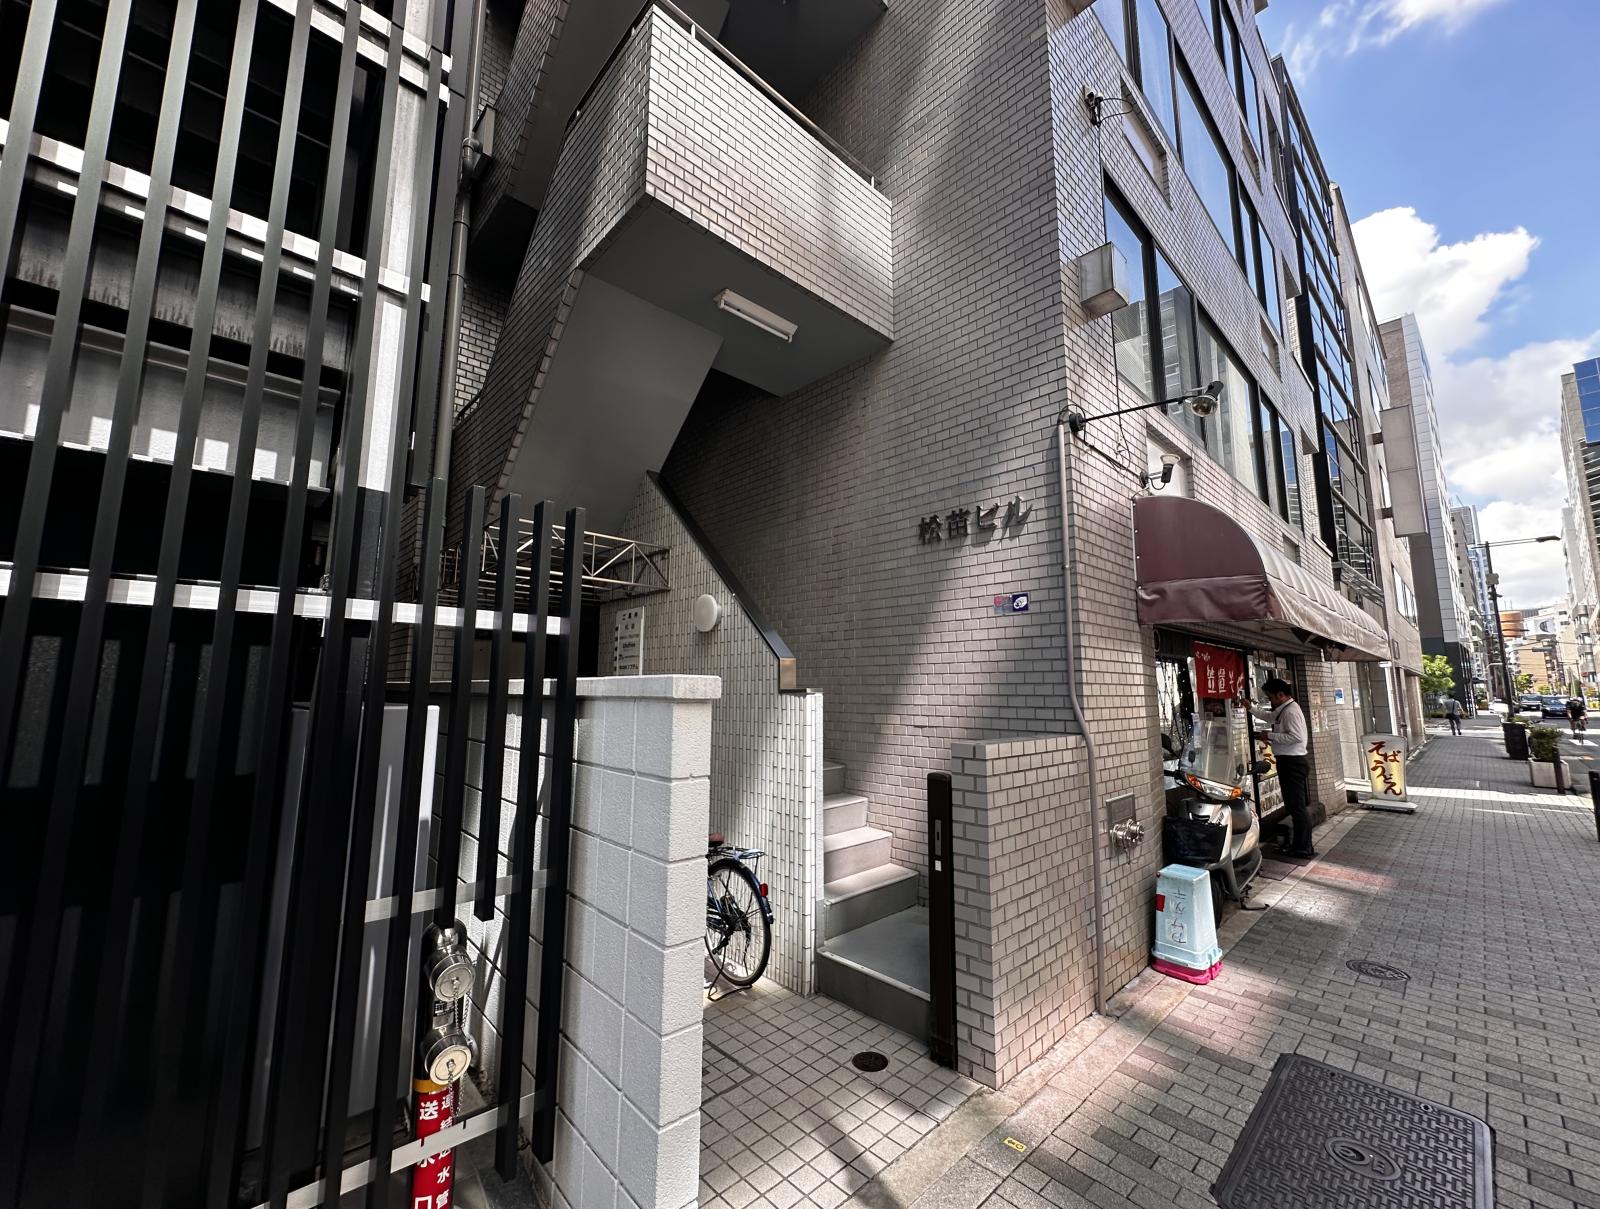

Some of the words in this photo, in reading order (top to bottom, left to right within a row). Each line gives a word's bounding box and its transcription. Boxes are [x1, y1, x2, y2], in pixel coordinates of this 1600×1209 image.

[1368, 741, 1402, 762] そば
[1371, 760, 1402, 796] うどん
